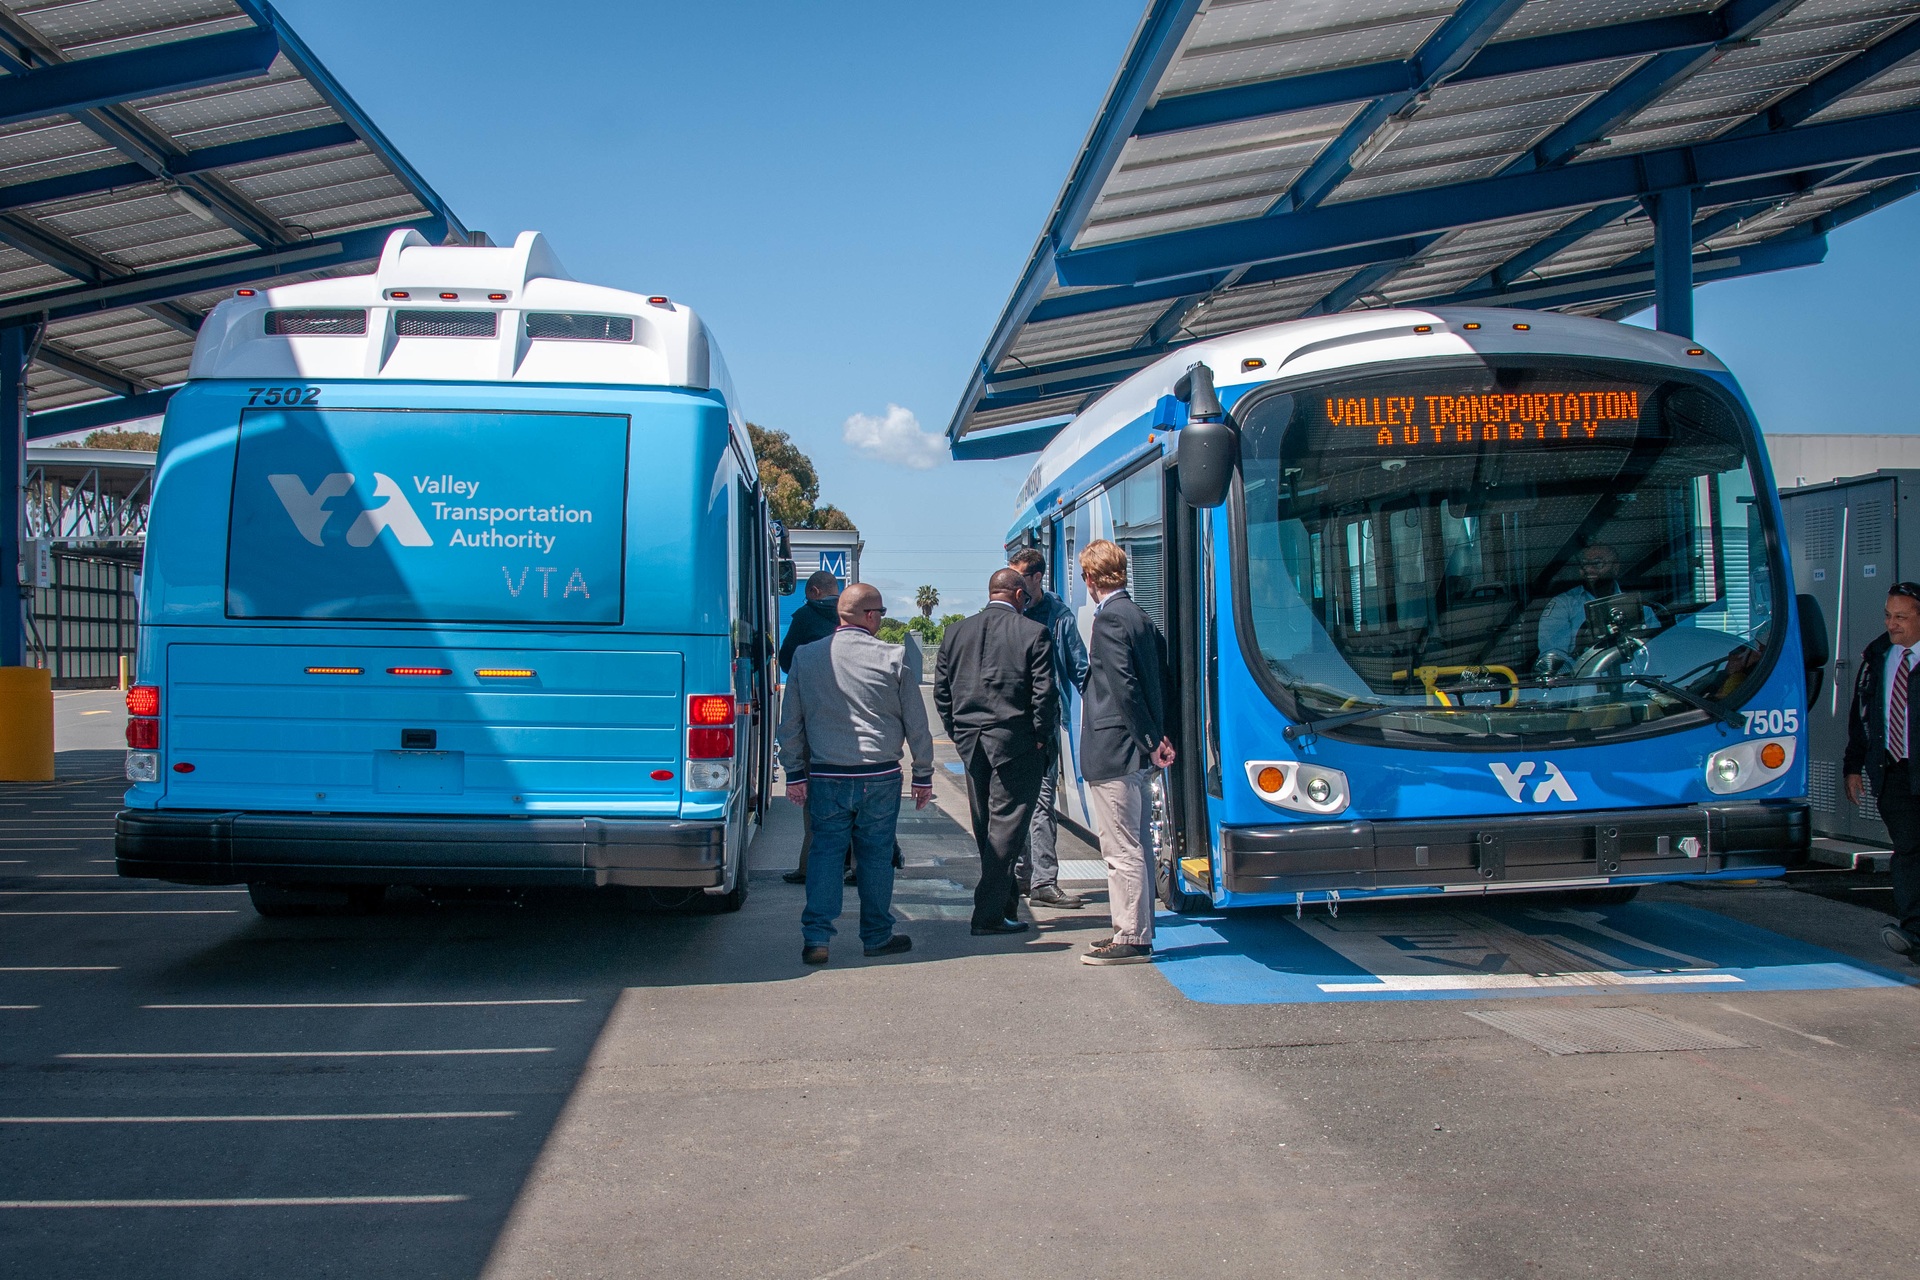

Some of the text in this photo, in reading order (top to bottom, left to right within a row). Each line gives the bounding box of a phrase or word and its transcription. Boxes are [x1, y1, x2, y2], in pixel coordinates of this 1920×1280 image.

[247, 387, 322, 406] 7502
[1326, 391, 1638, 426] VALLEY TRANSPORTATION
[1377, 421, 1598, 445] AUTHORITY
[413, 475, 480, 499] Valley
[431, 502, 593, 526] Transportation
[449, 529, 557, 554] Authority
[502, 566, 591, 600] VTA
[1743, 709, 1799, 735] 7505
